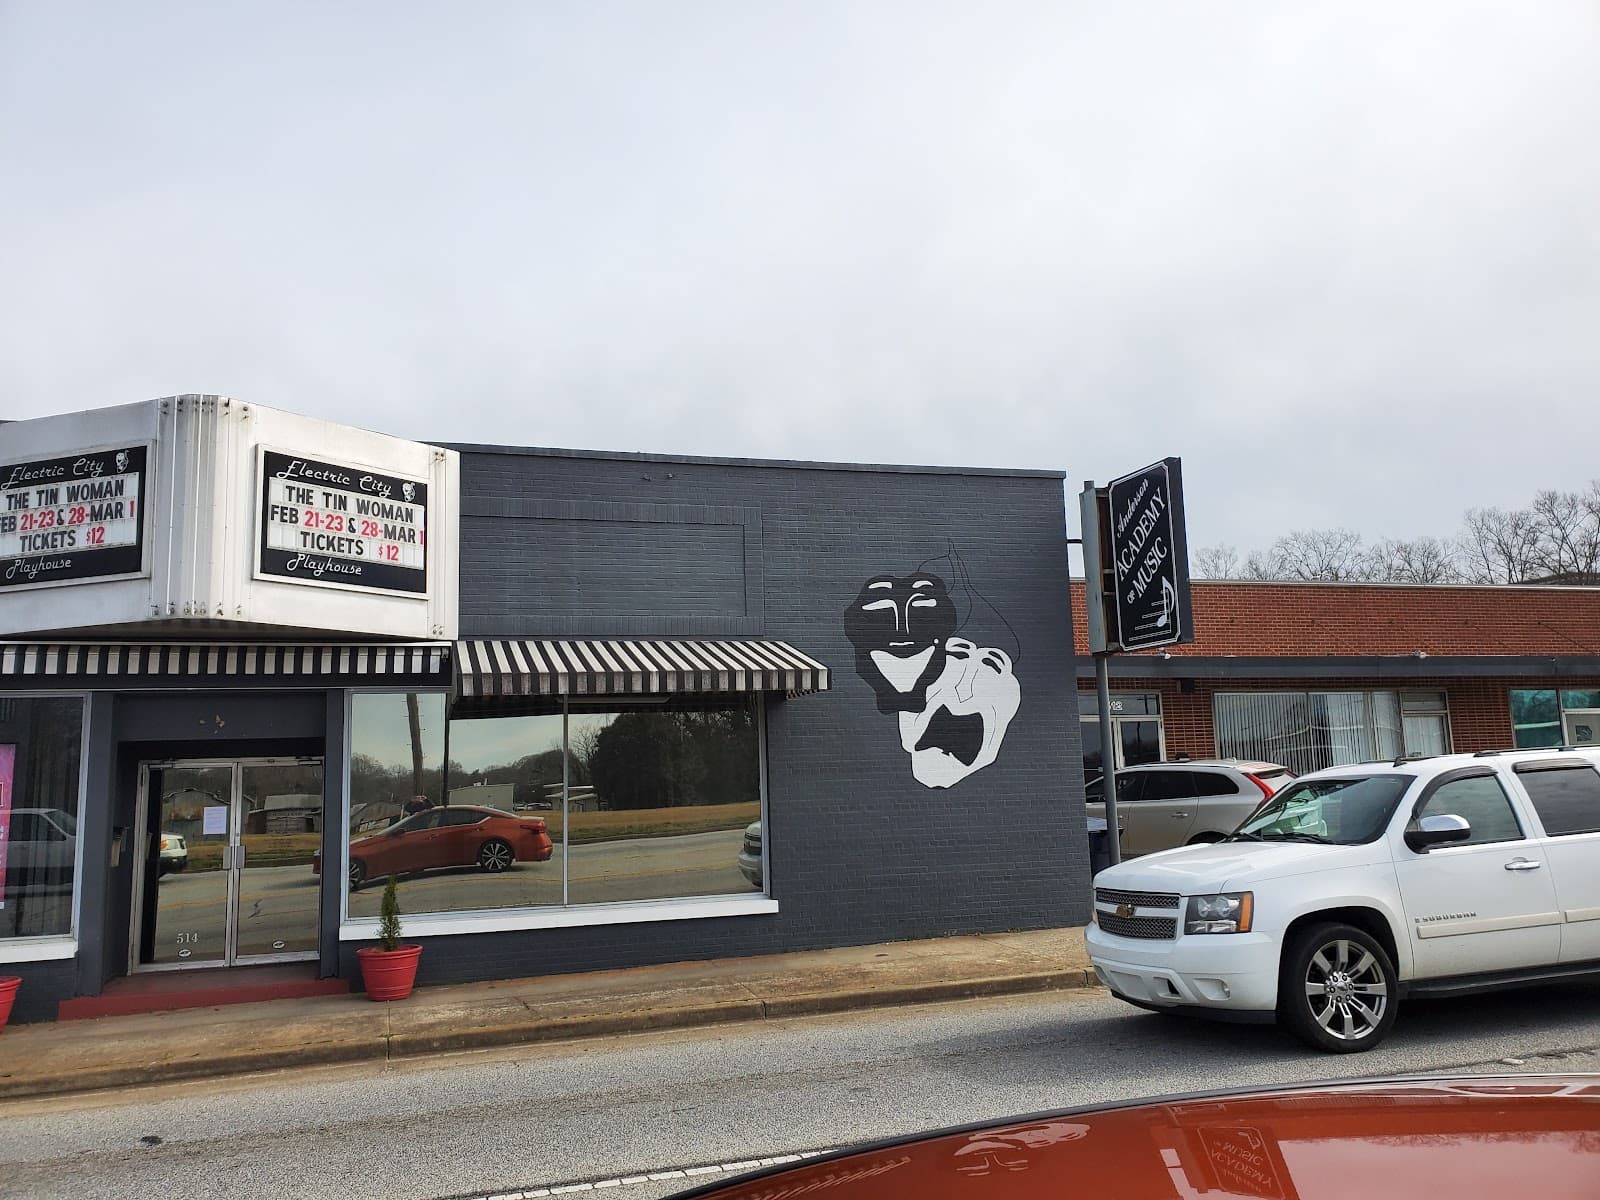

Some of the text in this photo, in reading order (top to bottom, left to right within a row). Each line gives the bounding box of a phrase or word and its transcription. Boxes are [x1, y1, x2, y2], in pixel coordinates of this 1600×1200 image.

[1, 458, 104, 489] Electric City
[276, 460, 392, 498] Electric City
[6, 479, 125, 510] THE TIN WOMAN
[285, 485, 414, 523] THE TIN WOMAN
[1117, 477, 1149, 538] Anderson
[271, 505, 299, 524] FEB
[304, 510, 344, 532] 21-23
[348, 517, 357, 534] &
[1116, 487, 1166, 582] ACADEMY
[20, 526, 105, 552] TICKETS $12
[300, 531, 399, 561] TICKETS $12
[5, 556, 72, 579] Playhouse
[287, 553, 362, 577] Playhouse
[1132, 537, 1168, 599] MUSIC
[176, 932, 199, 944] 514
